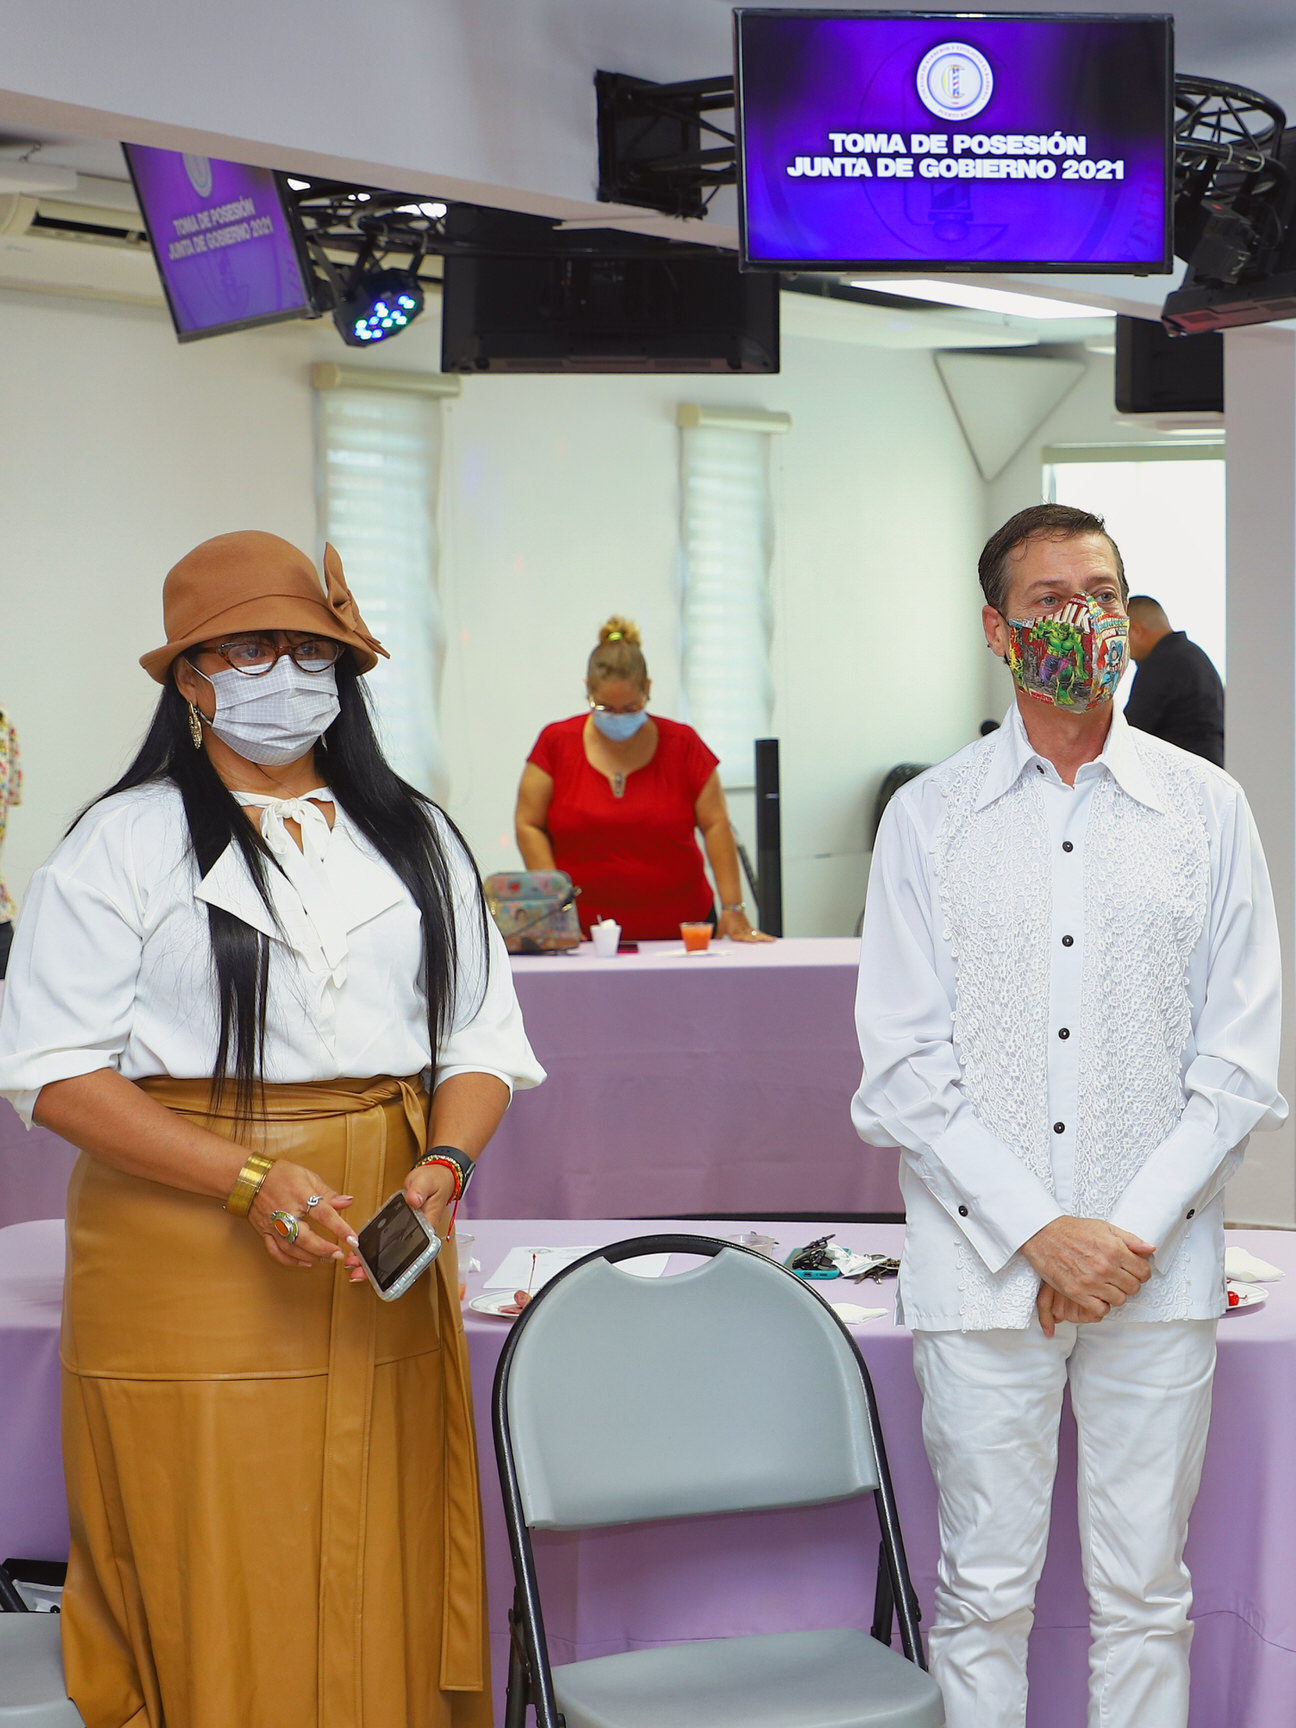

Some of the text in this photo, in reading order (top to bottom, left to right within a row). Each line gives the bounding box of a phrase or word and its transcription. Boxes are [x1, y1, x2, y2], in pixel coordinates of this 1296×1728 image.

[828, 131, 1086, 155] TOMA DE POSESIÓN
[786, 156, 1124, 179] JUNTA DE GOBIERNO 2021
[173, 195, 256, 236] TOMA DE POSESIÓN
[168, 215, 274, 261] JUNTA DE GOBIERNO 2021
